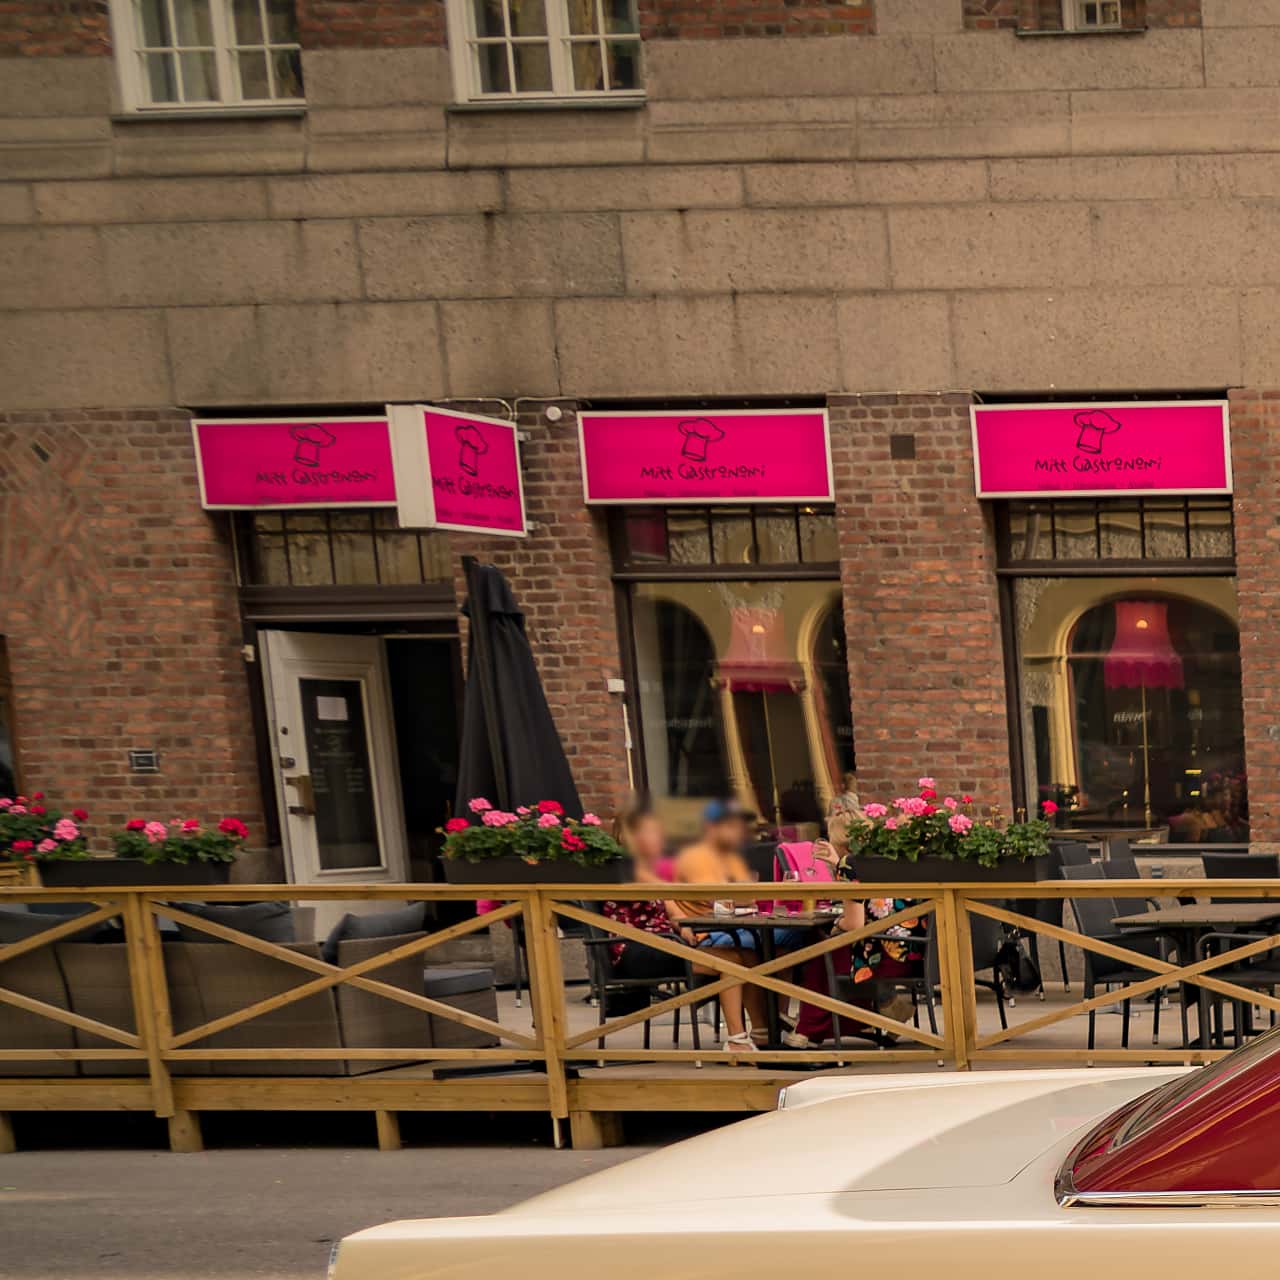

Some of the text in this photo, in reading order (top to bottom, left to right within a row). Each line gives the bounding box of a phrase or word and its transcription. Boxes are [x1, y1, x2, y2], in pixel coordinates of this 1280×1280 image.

[639, 463, 766, 481] Mitt Gastronomi
[1033, 455, 1163, 474] Mitt Gastronomi
[458, 476, 515, 499] Gastronom
